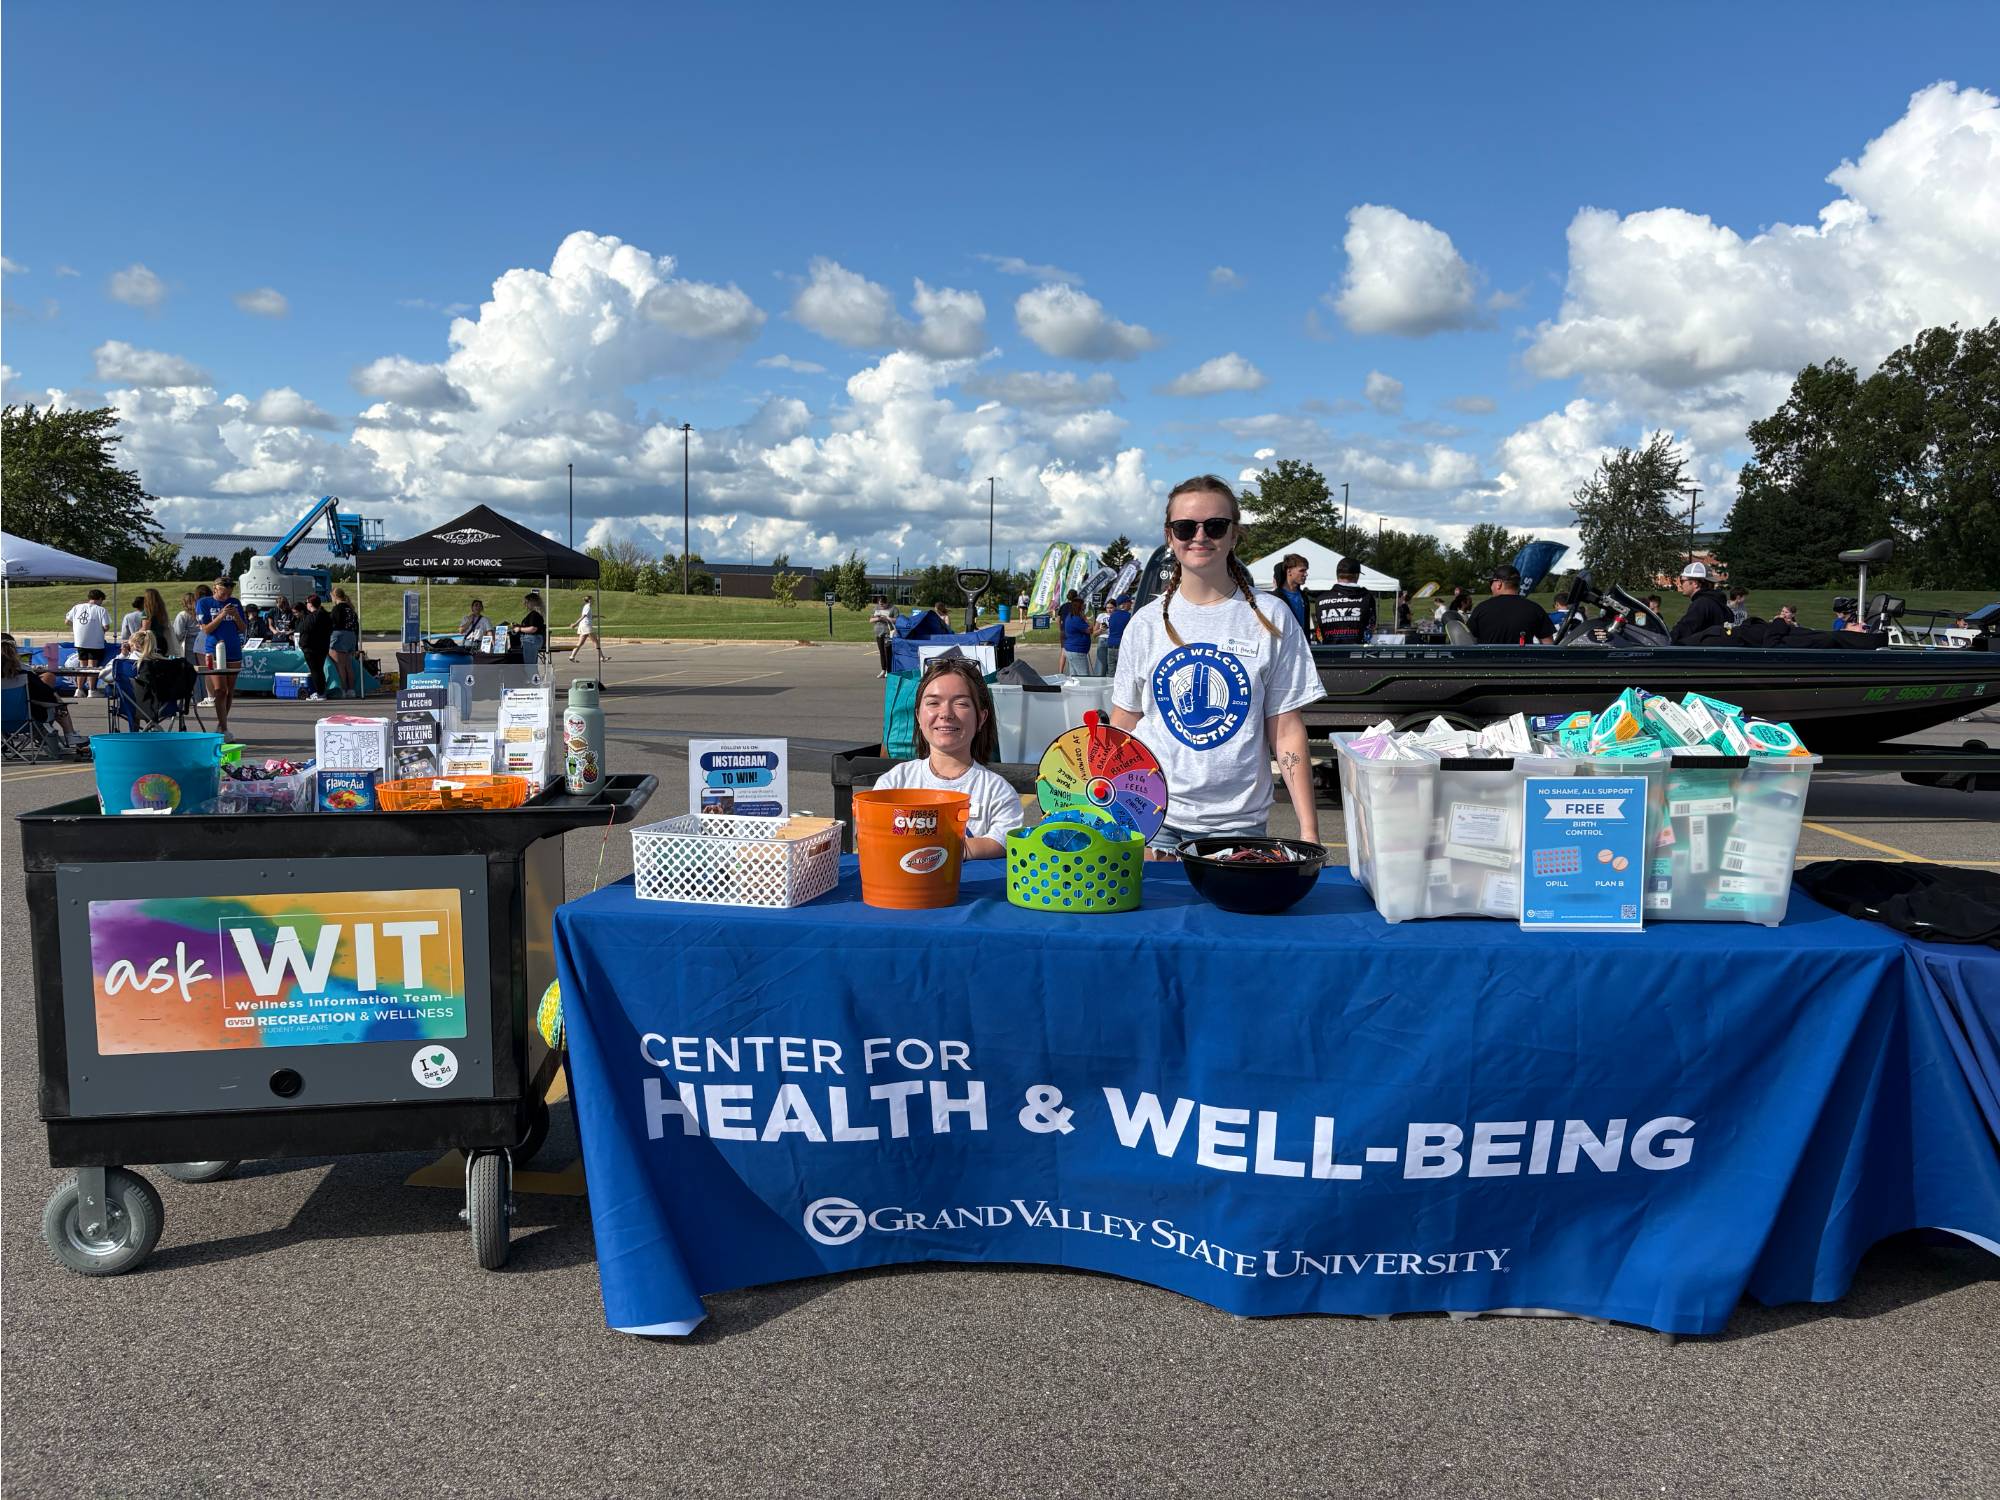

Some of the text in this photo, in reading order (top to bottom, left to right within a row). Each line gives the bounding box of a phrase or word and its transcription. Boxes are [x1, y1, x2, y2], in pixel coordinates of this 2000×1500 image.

[403, 558, 503, 567] GLC LIVE AT 20 MONROE
[1319, 597, 1363, 606] ERICKSON
[1321, 607, 1361, 618] JAY'S
[1349, 651, 1455, 659] SKEETER
[1190, 648, 1248, 696] WELCOME
[401, 699, 433, 708] EL ACECHO
[1167, 709, 1238, 745] ROCKSTAR
[397, 731, 433, 741] STALKING
[712, 755, 767, 768] INSTAGRAM
[721, 772, 758, 784] TO WIN!
[1128, 773, 1146, 784] BIG
[326, 778, 364, 792] Flavor Aid
[1125, 783, 1148, 794] FEELS
[1551, 788, 1581, 796] SHAME,
[1565, 803, 1605, 814] FREE
[894, 816, 937, 829] GVSU
[229, 920, 439, 996] WIT
[104, 941, 213, 1003] ask
[235, 993, 442, 1011] Wellness Information Team
[258, 1012, 356, 1026] RECREATION
[360, 1011, 370, 1021] &
[374, 1008, 454, 1020] WELLNESS
[296, 1025, 329, 1033] AFFAIRS
[640, 1032, 972, 1075] CENTER FOR
[419, 1058, 430, 1071] I
[424, 1065, 452, 1079] Sex Ed
[642, 1077, 1696, 1180] HEALTH & WELL-BEING
[868, 1199, 1510, 1278] GRAND VALLEY STATE UNIVERSITY
